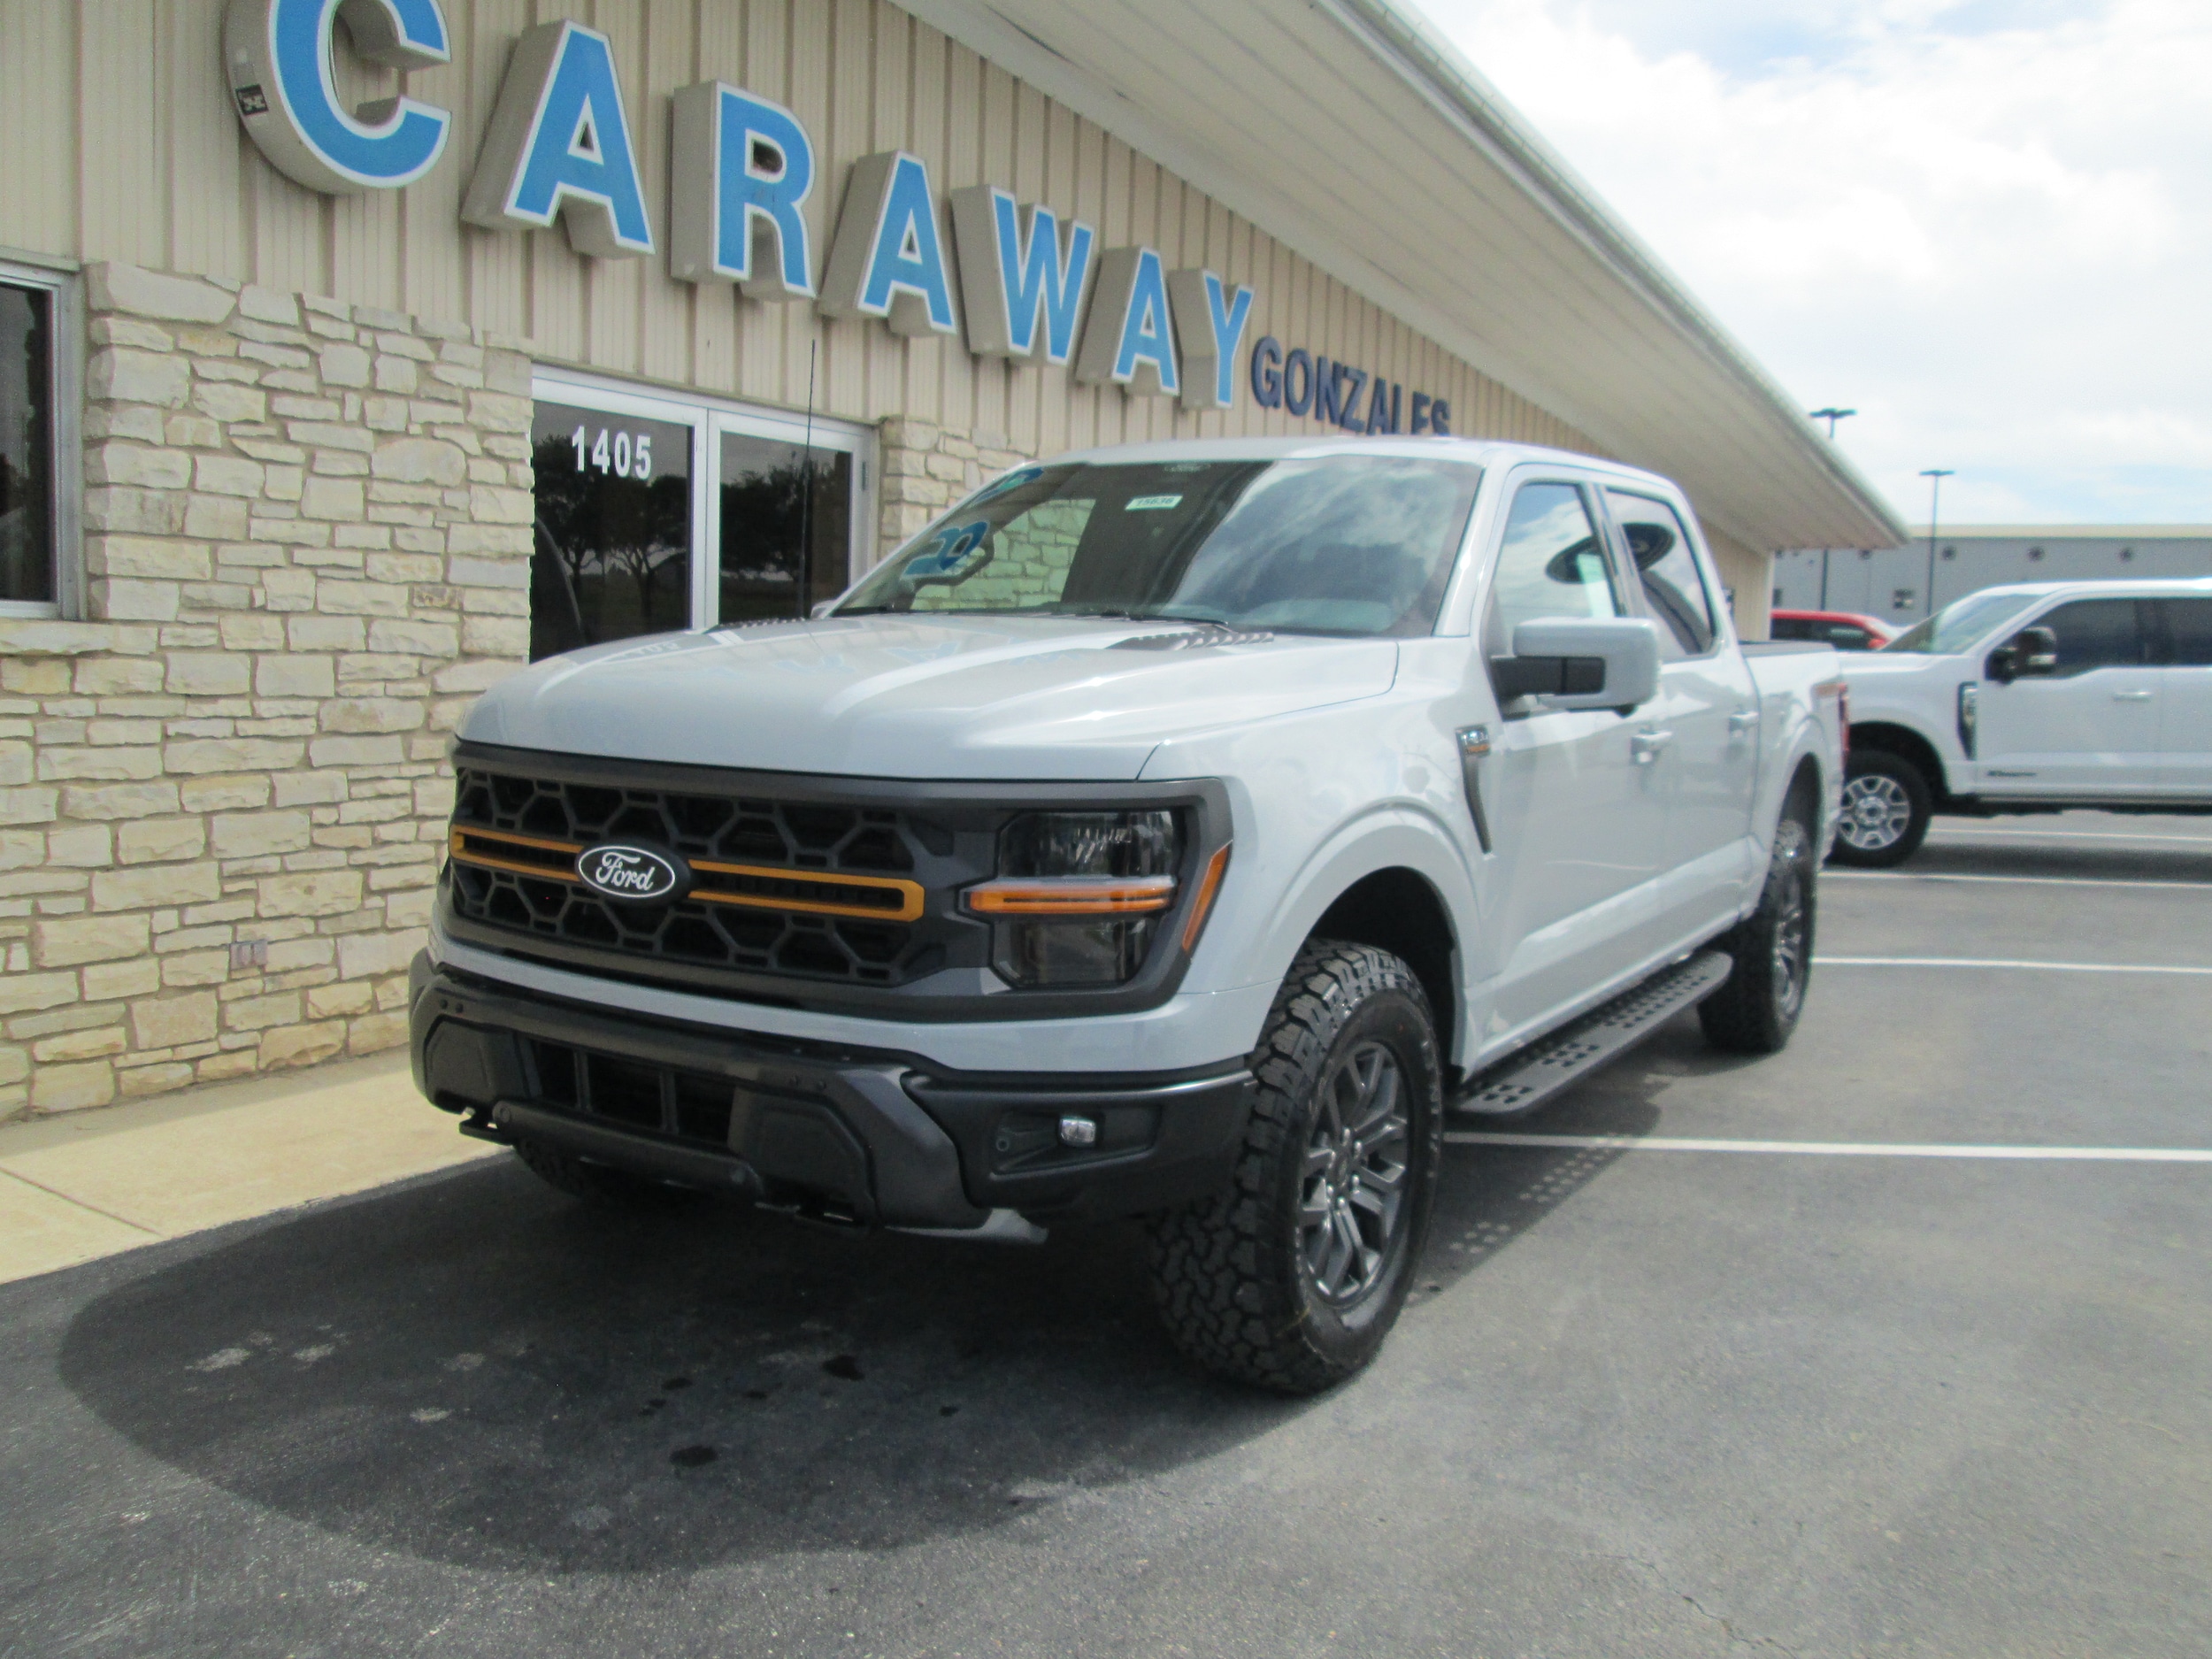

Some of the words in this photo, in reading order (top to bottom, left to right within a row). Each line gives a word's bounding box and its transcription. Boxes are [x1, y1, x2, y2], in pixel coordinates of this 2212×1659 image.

[267, 0, 1255, 409] CARAWAY
[572, 425, 651, 480] 1405
[595, 851, 656, 891] Ford
